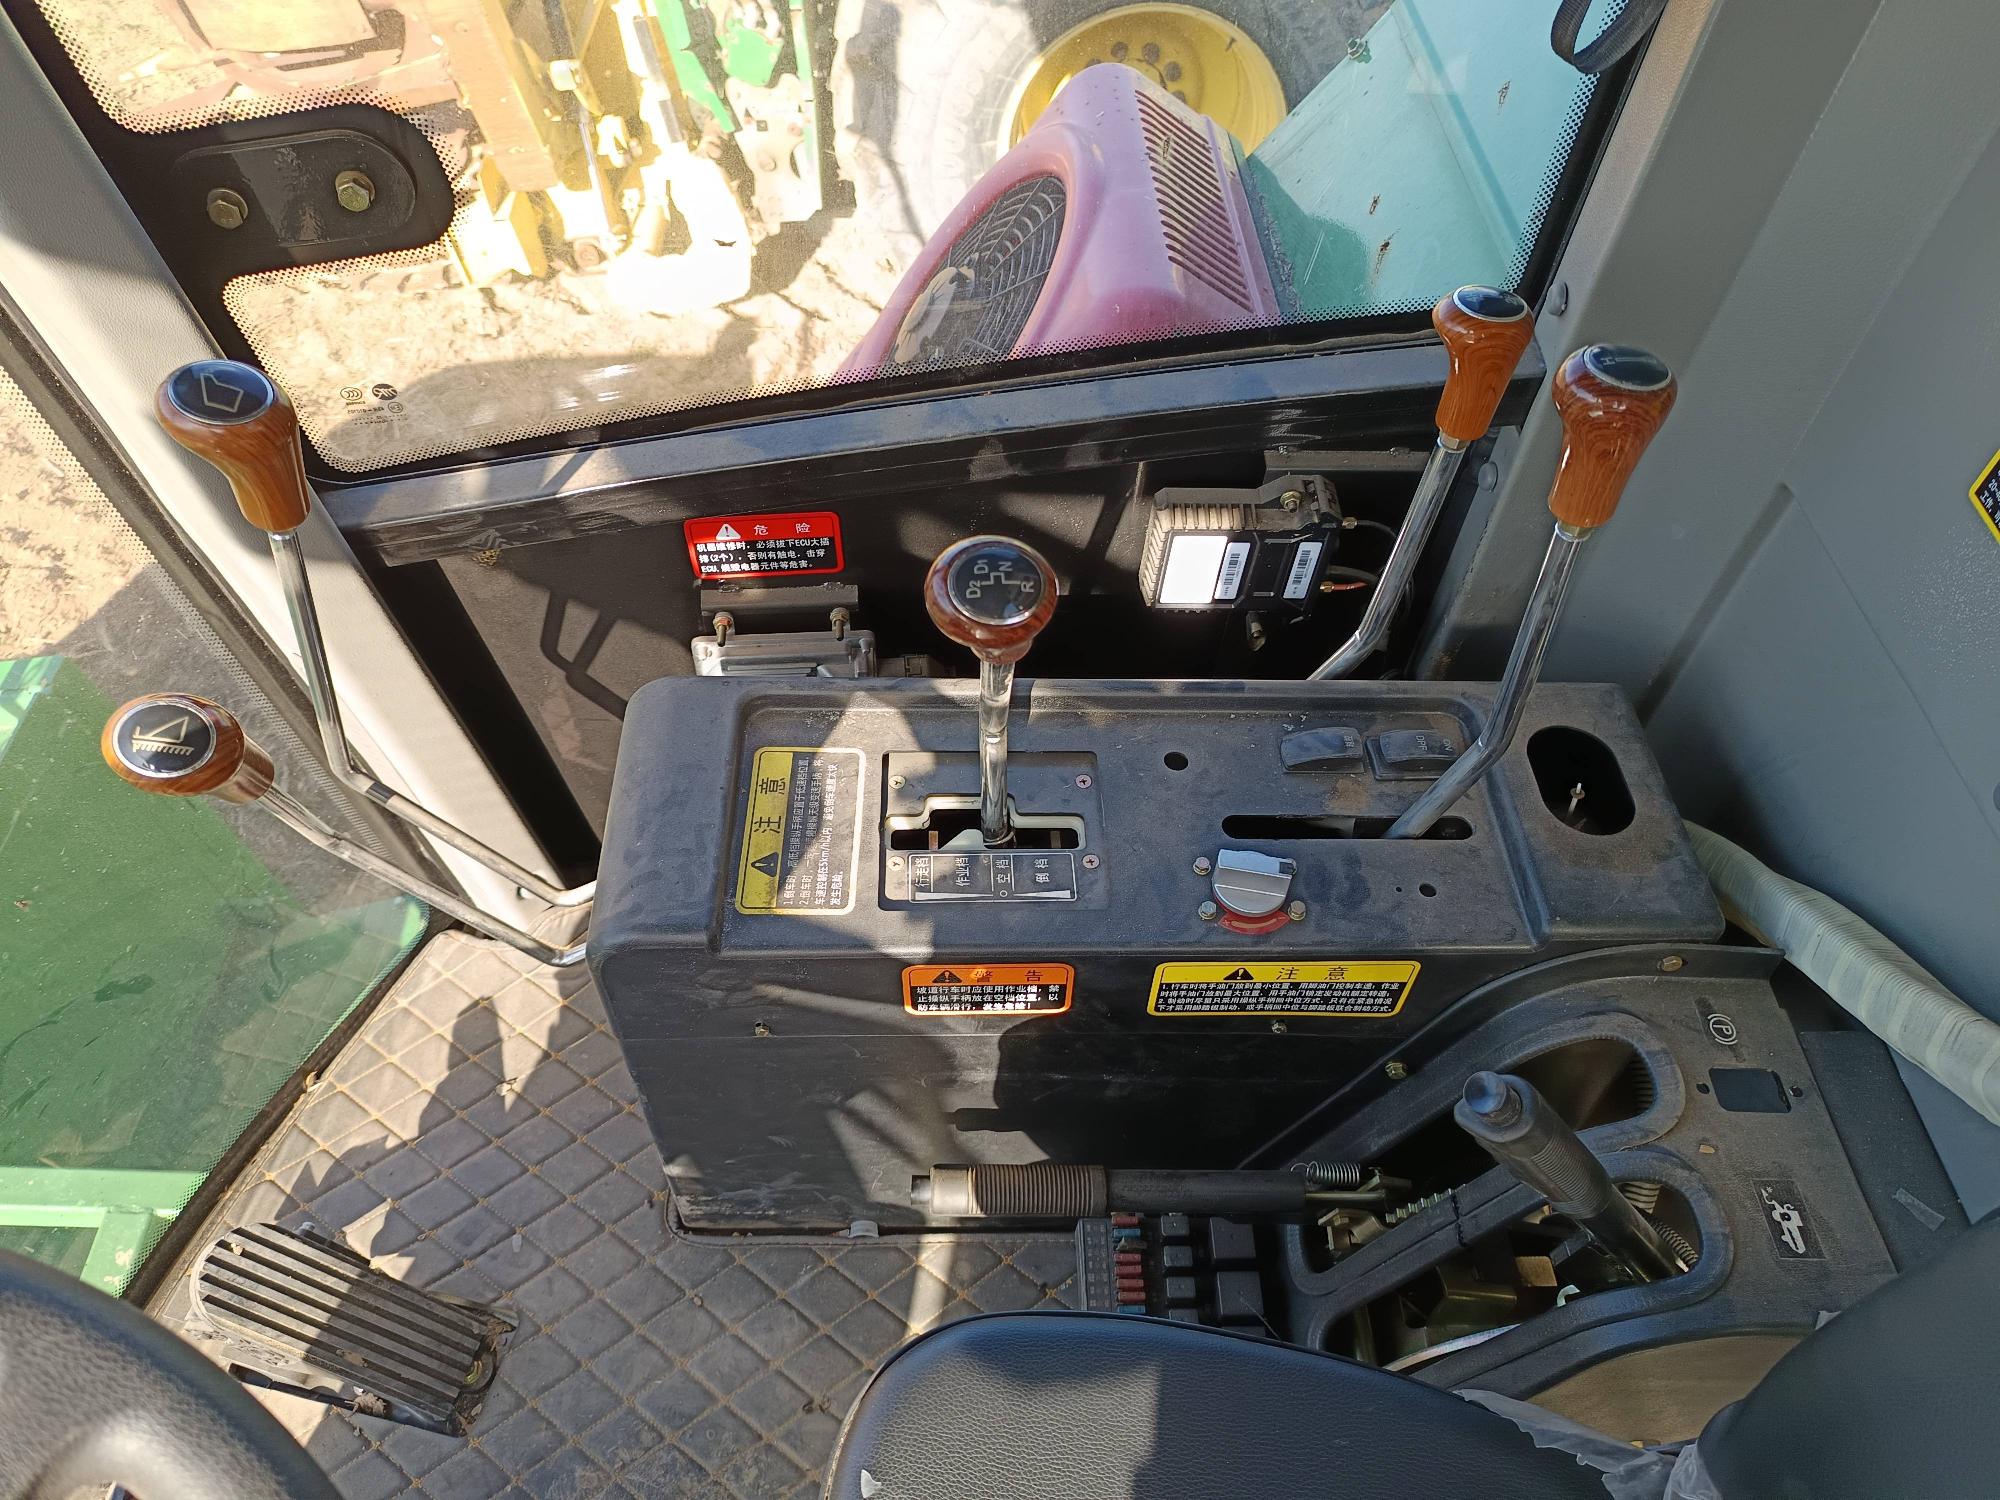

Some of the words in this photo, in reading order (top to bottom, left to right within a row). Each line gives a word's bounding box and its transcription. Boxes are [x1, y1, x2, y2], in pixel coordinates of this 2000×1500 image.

[754, 522, 811, 536] 危险
[974, 559, 989, 574] D1
[998, 561, 1014, 572] N
[966, 580, 982, 599] D2
[1021, 580, 1035, 593] R
[1415, 735, 1428, 751] DPF
[754, 777, 786, 834] 注意
[914, 857, 931, 887] 行走档
[955, 858, 970, 887] 作业档
[995, 859, 1011, 884] 空档
[1035, 859, 1050, 883] 倒档
[974, 970, 1043, 983] 警告
[1276, 966, 1350, 981] 注意
